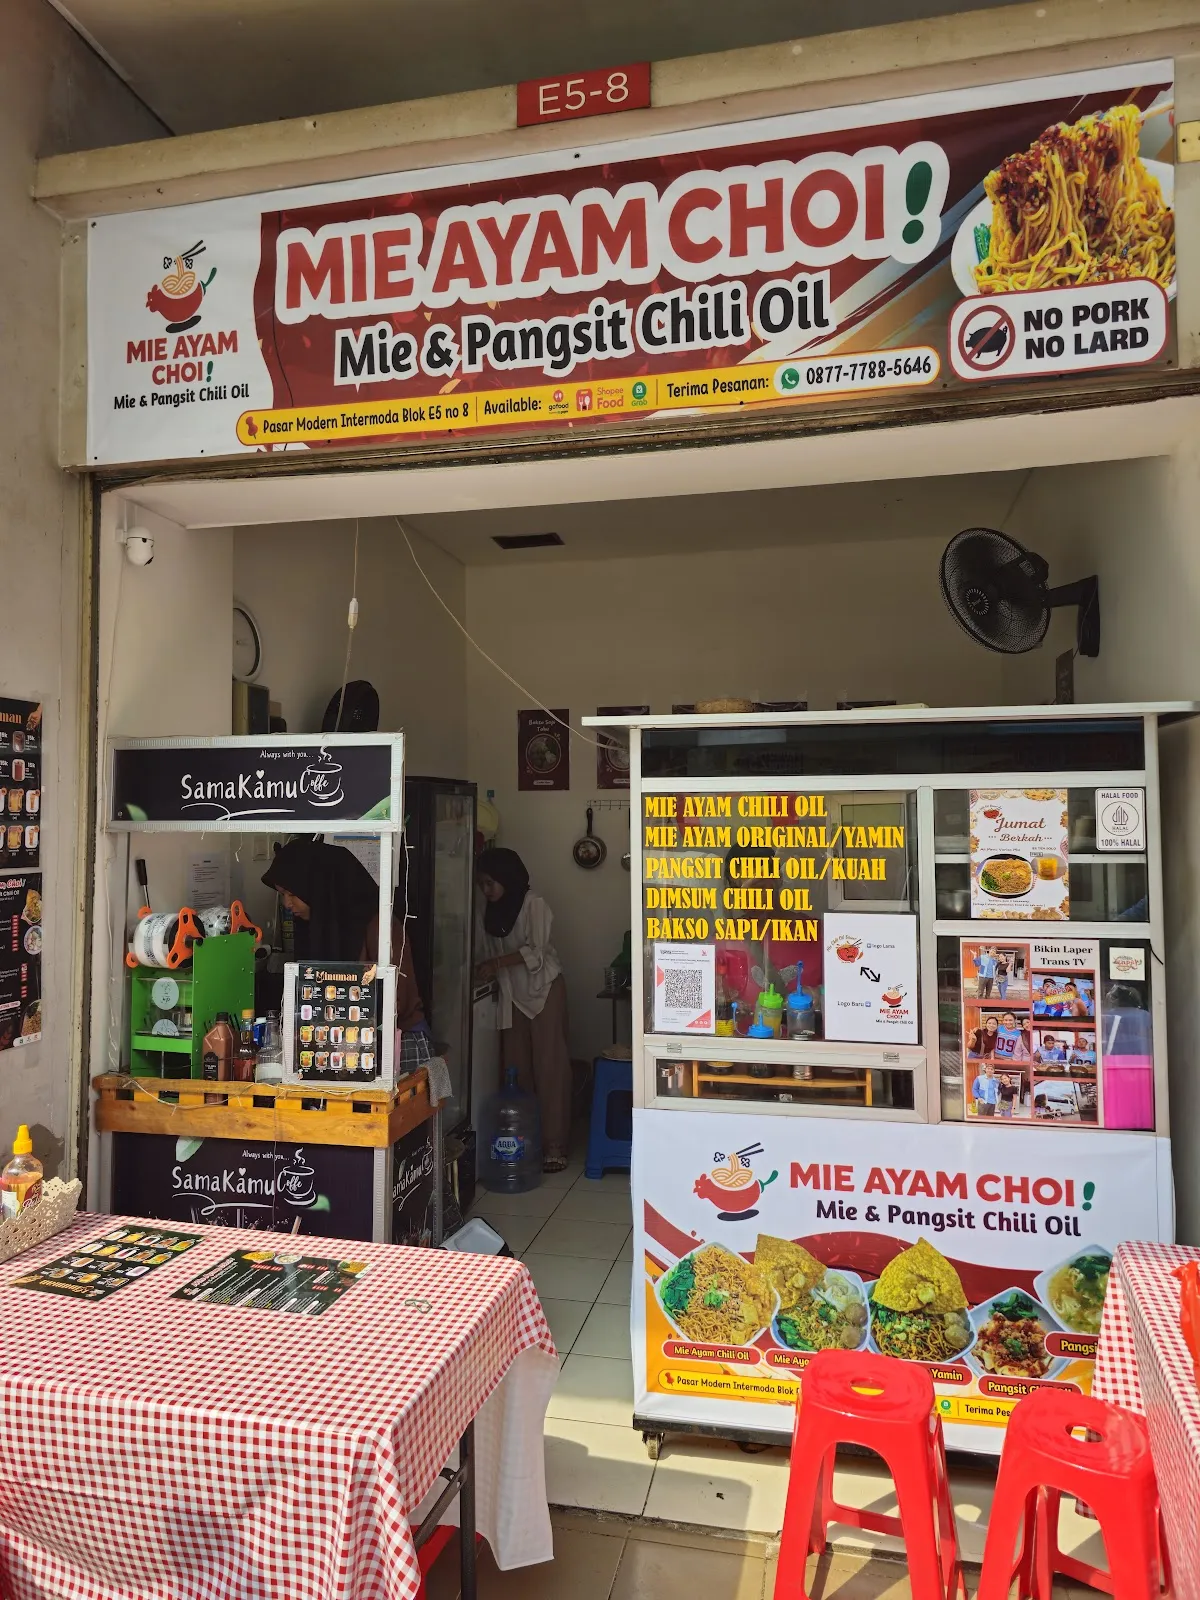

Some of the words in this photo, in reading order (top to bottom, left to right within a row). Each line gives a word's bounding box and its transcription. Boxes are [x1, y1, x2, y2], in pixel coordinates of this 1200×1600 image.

[538, 72, 630, 116] E5-8
[286, 227, 414, 310] MIE
[432, 197, 649, 294] AYAM
[668, 160, 934, 264] CHOI!
[1023, 306, 1065, 332] NO
[1072, 297, 1150, 329] PORK
[340, 329, 412, 379] Mie
[426, 335, 454, 371] &
[466, 304, 628, 372] Pangsit
[642, 289, 744, 342] Chili
[759, 278, 830, 335] Oil
[126, 338, 168, 364] MIE
[172, 330, 239, 360] AYAM
[1024, 335, 1066, 361] NO
[1073, 325, 1150, 357] LARD
[152, 360, 214, 386] CHOI!
[805, 355, 933, 386] 0877-7788-5646
[113, 394, 136, 410] Mie
[139, 395, 148, 408] &
[151, 388, 196, 408] Pangsit
[199, 384, 228, 402] Chili
[231, 383, 250, 399] Oil
[597, 387, 625, 396] Shopee
[666, 379, 709, 399] Terima
[712, 376, 770, 395] Pesanan:
[484, 396, 542, 416] Available:
[548, 402, 570, 411] gofood
[597, 396, 625, 410] Food
[263, 419, 294, 434] Pasar
[296, 415, 339, 432] Modern
[340, 409, 400, 428] Intermoda
[402, 406, 426, 423] Blok
[428, 405, 442, 420] E5
[445, 406, 460, 418] no
[462, 402, 469, 417] 8
[260, 750, 281, 760] Always
[283, 750, 296, 759] with
[645, 796, 678, 818] MIE
[683, 796, 732, 817] AYAM
[738, 796, 789, 818] CHILI
[794, 796, 828, 817] OIL
[994, 813, 1047, 832] Jumat
[645, 826, 678, 848] MIE
[683, 826, 732, 848] AYAM
[736, 826, 905, 849] ORIGINAL/YAMIN
[999, 833, 1043, 842] Berkah
[1101, 838, 1119, 847] 100%
[1120, 838, 1141, 847] HALAL
[645, 857, 723, 879] PANGSIT
[729, 857, 781, 879] CHILI
[786, 857, 887, 880] OIL/KUAH
[646, 887, 718, 910] DIMSUM
[723, 888, 774, 911] CHILI
[779, 888, 813, 911] OIL
[646, 917, 709, 940] BAKSO
[714, 918, 819, 942] SAPI/IKAN
[1033, 945, 1061, 954] Bikin
[1063, 945, 1094, 956] Laper
[1040, 957, 1071, 966] Trans
[1072, 958, 1087, 966] TV
[316, 970, 358, 984] Minuman
[837, 1000, 850, 1008] Logo
[497, 1140, 516, 1149] AQUA
[261, 1151, 273, 1160] with
[790, 1161, 855, 1193] MIE
[863, 1167, 969, 1200] AYAM
[976, 1173, 1096, 1211] CHOI!
[815, 1199, 858, 1222] Mie
[865, 1204, 881, 1222] &
[887, 1202, 976, 1232] Pangsit
[982, 1208, 1037, 1234] Chili
[1044, 1214, 1082, 1237] Oil
[674, 1345, 690, 1356] Mie
[691, 1347, 716, 1358] Ayam
[716, 1349, 736, 1359] Chili
[737, 1350, 750, 1361] Oil
[1060, 1339, 1098, 1356] Pangsi
[773, 1353, 791, 1364] Mie
[792, 1355, 810, 1367] Aya
[931, 1368, 963, 1381] Yamin
[677, 1376, 698, 1387] Pasar
[701, 1378, 731, 1389] Modern
[733, 1381, 775, 1393] Intermoda
[777, 1385, 794, 1395] Blok
[988, 1381, 1028, 1396] Pangsit
[965, 1404, 994, 1416] Terima
